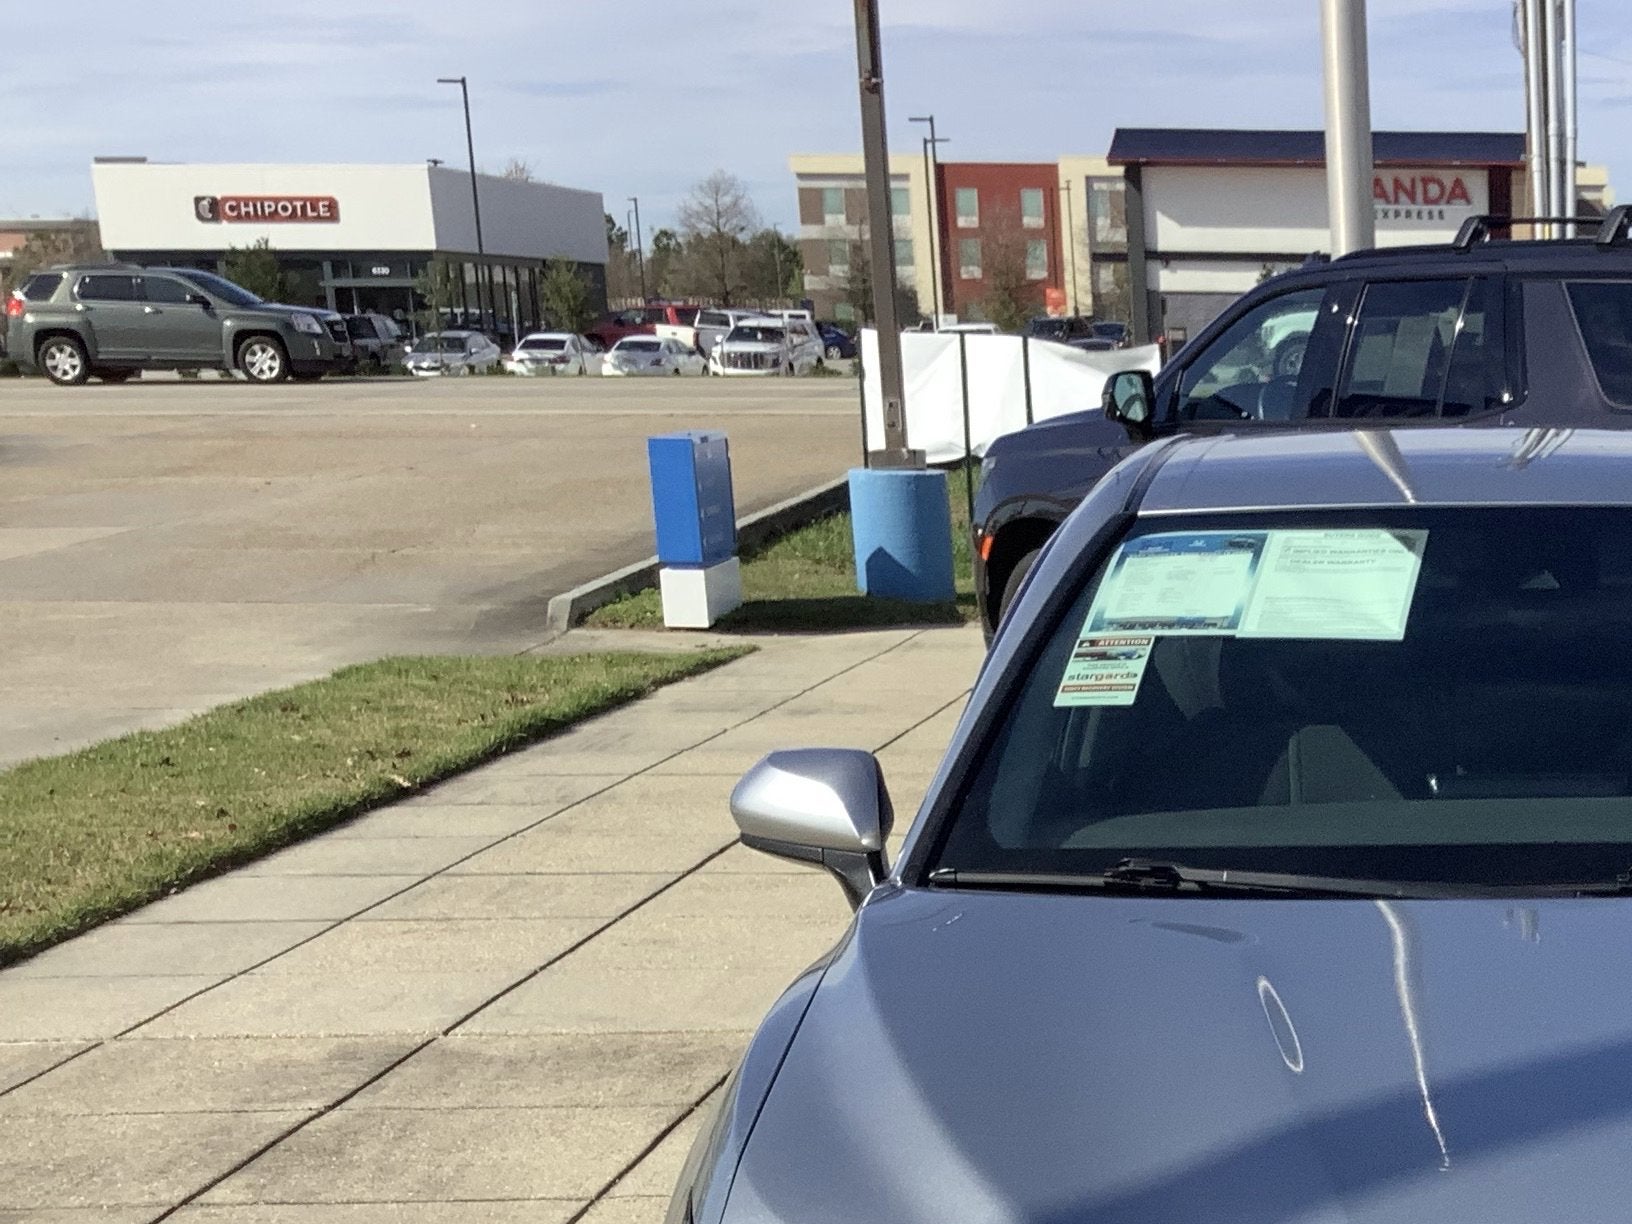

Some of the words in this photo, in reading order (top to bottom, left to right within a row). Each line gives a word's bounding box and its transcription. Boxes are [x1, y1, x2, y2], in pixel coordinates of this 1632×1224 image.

[1373, 176, 1472, 205] ANDA
[224, 201, 331, 217] CHIPOTLE
[1374, 209, 1446, 221] XPRESS
[1098, 639, 1149, 647] ATTENTION
